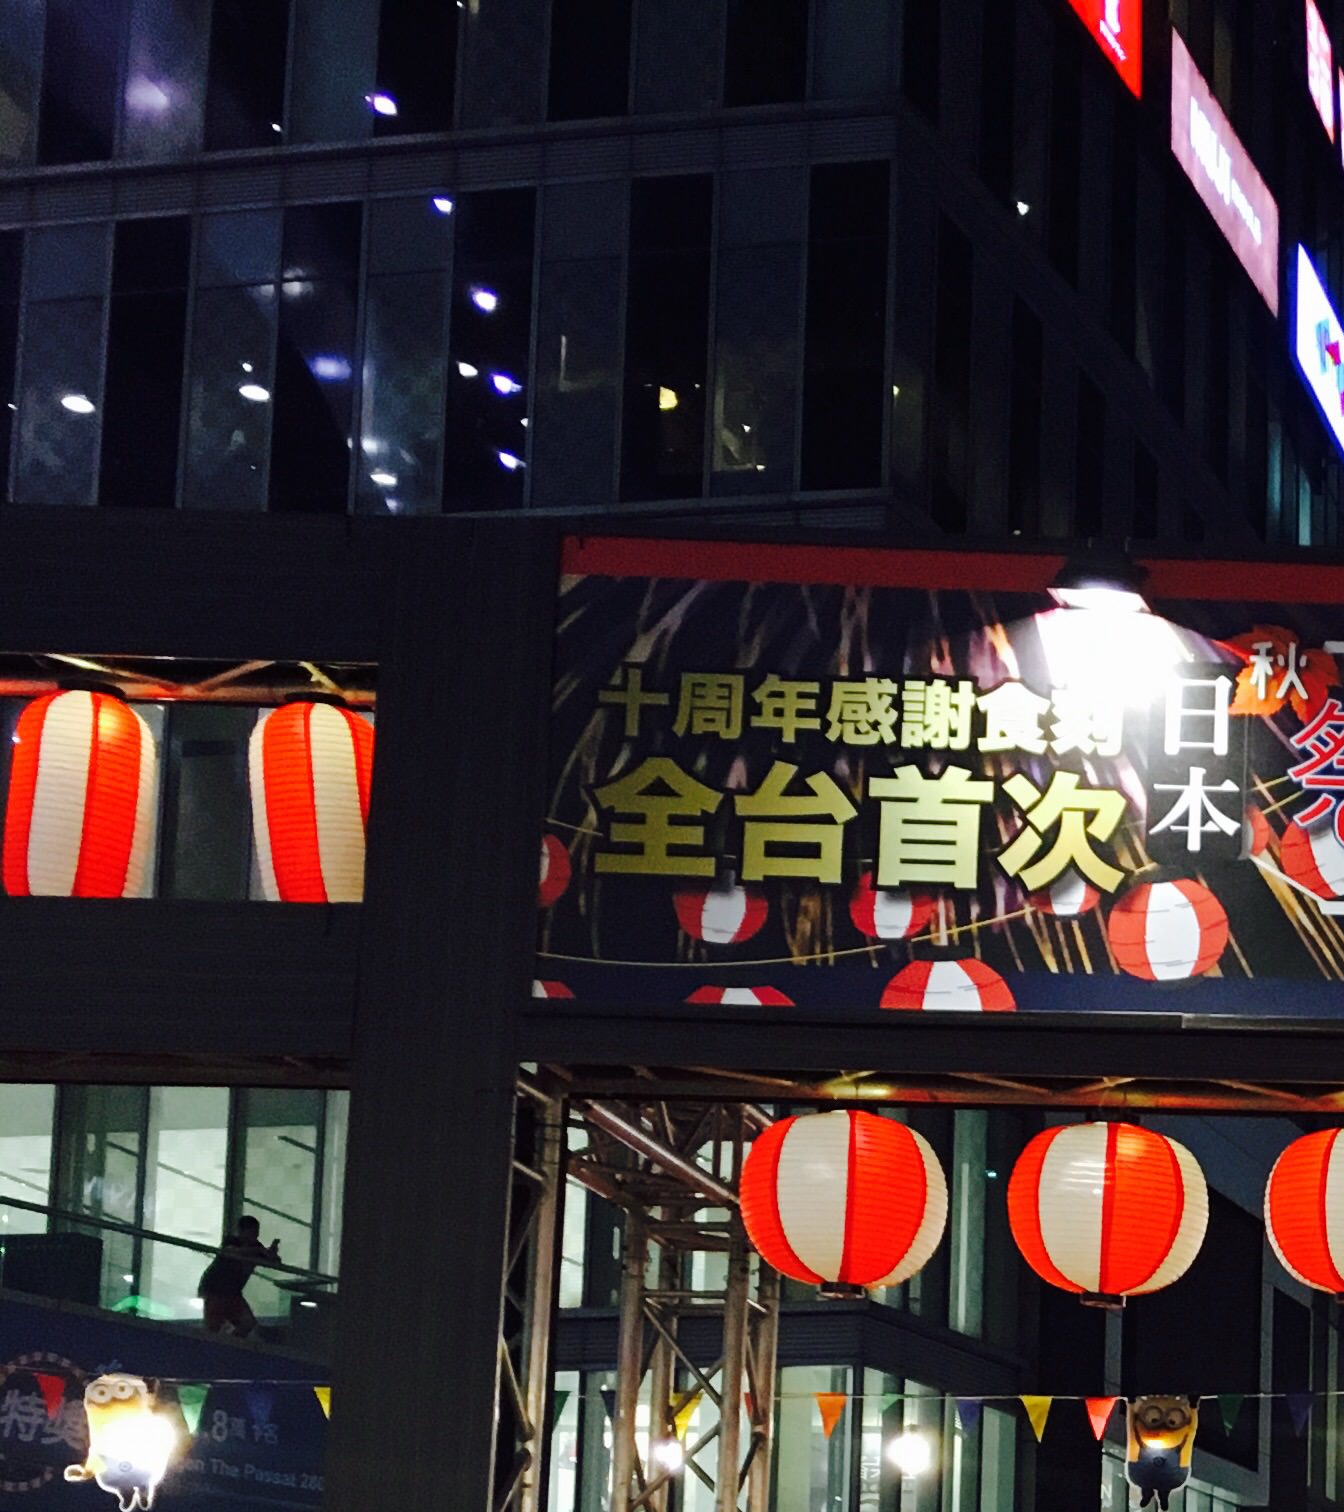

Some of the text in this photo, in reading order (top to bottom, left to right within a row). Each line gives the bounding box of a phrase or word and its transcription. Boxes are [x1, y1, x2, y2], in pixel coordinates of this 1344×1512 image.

[1249, 641, 1309, 701] 秋
[593, 758, 1128, 893] 全台首次
[1148, 673, 1241, 852] 日本
